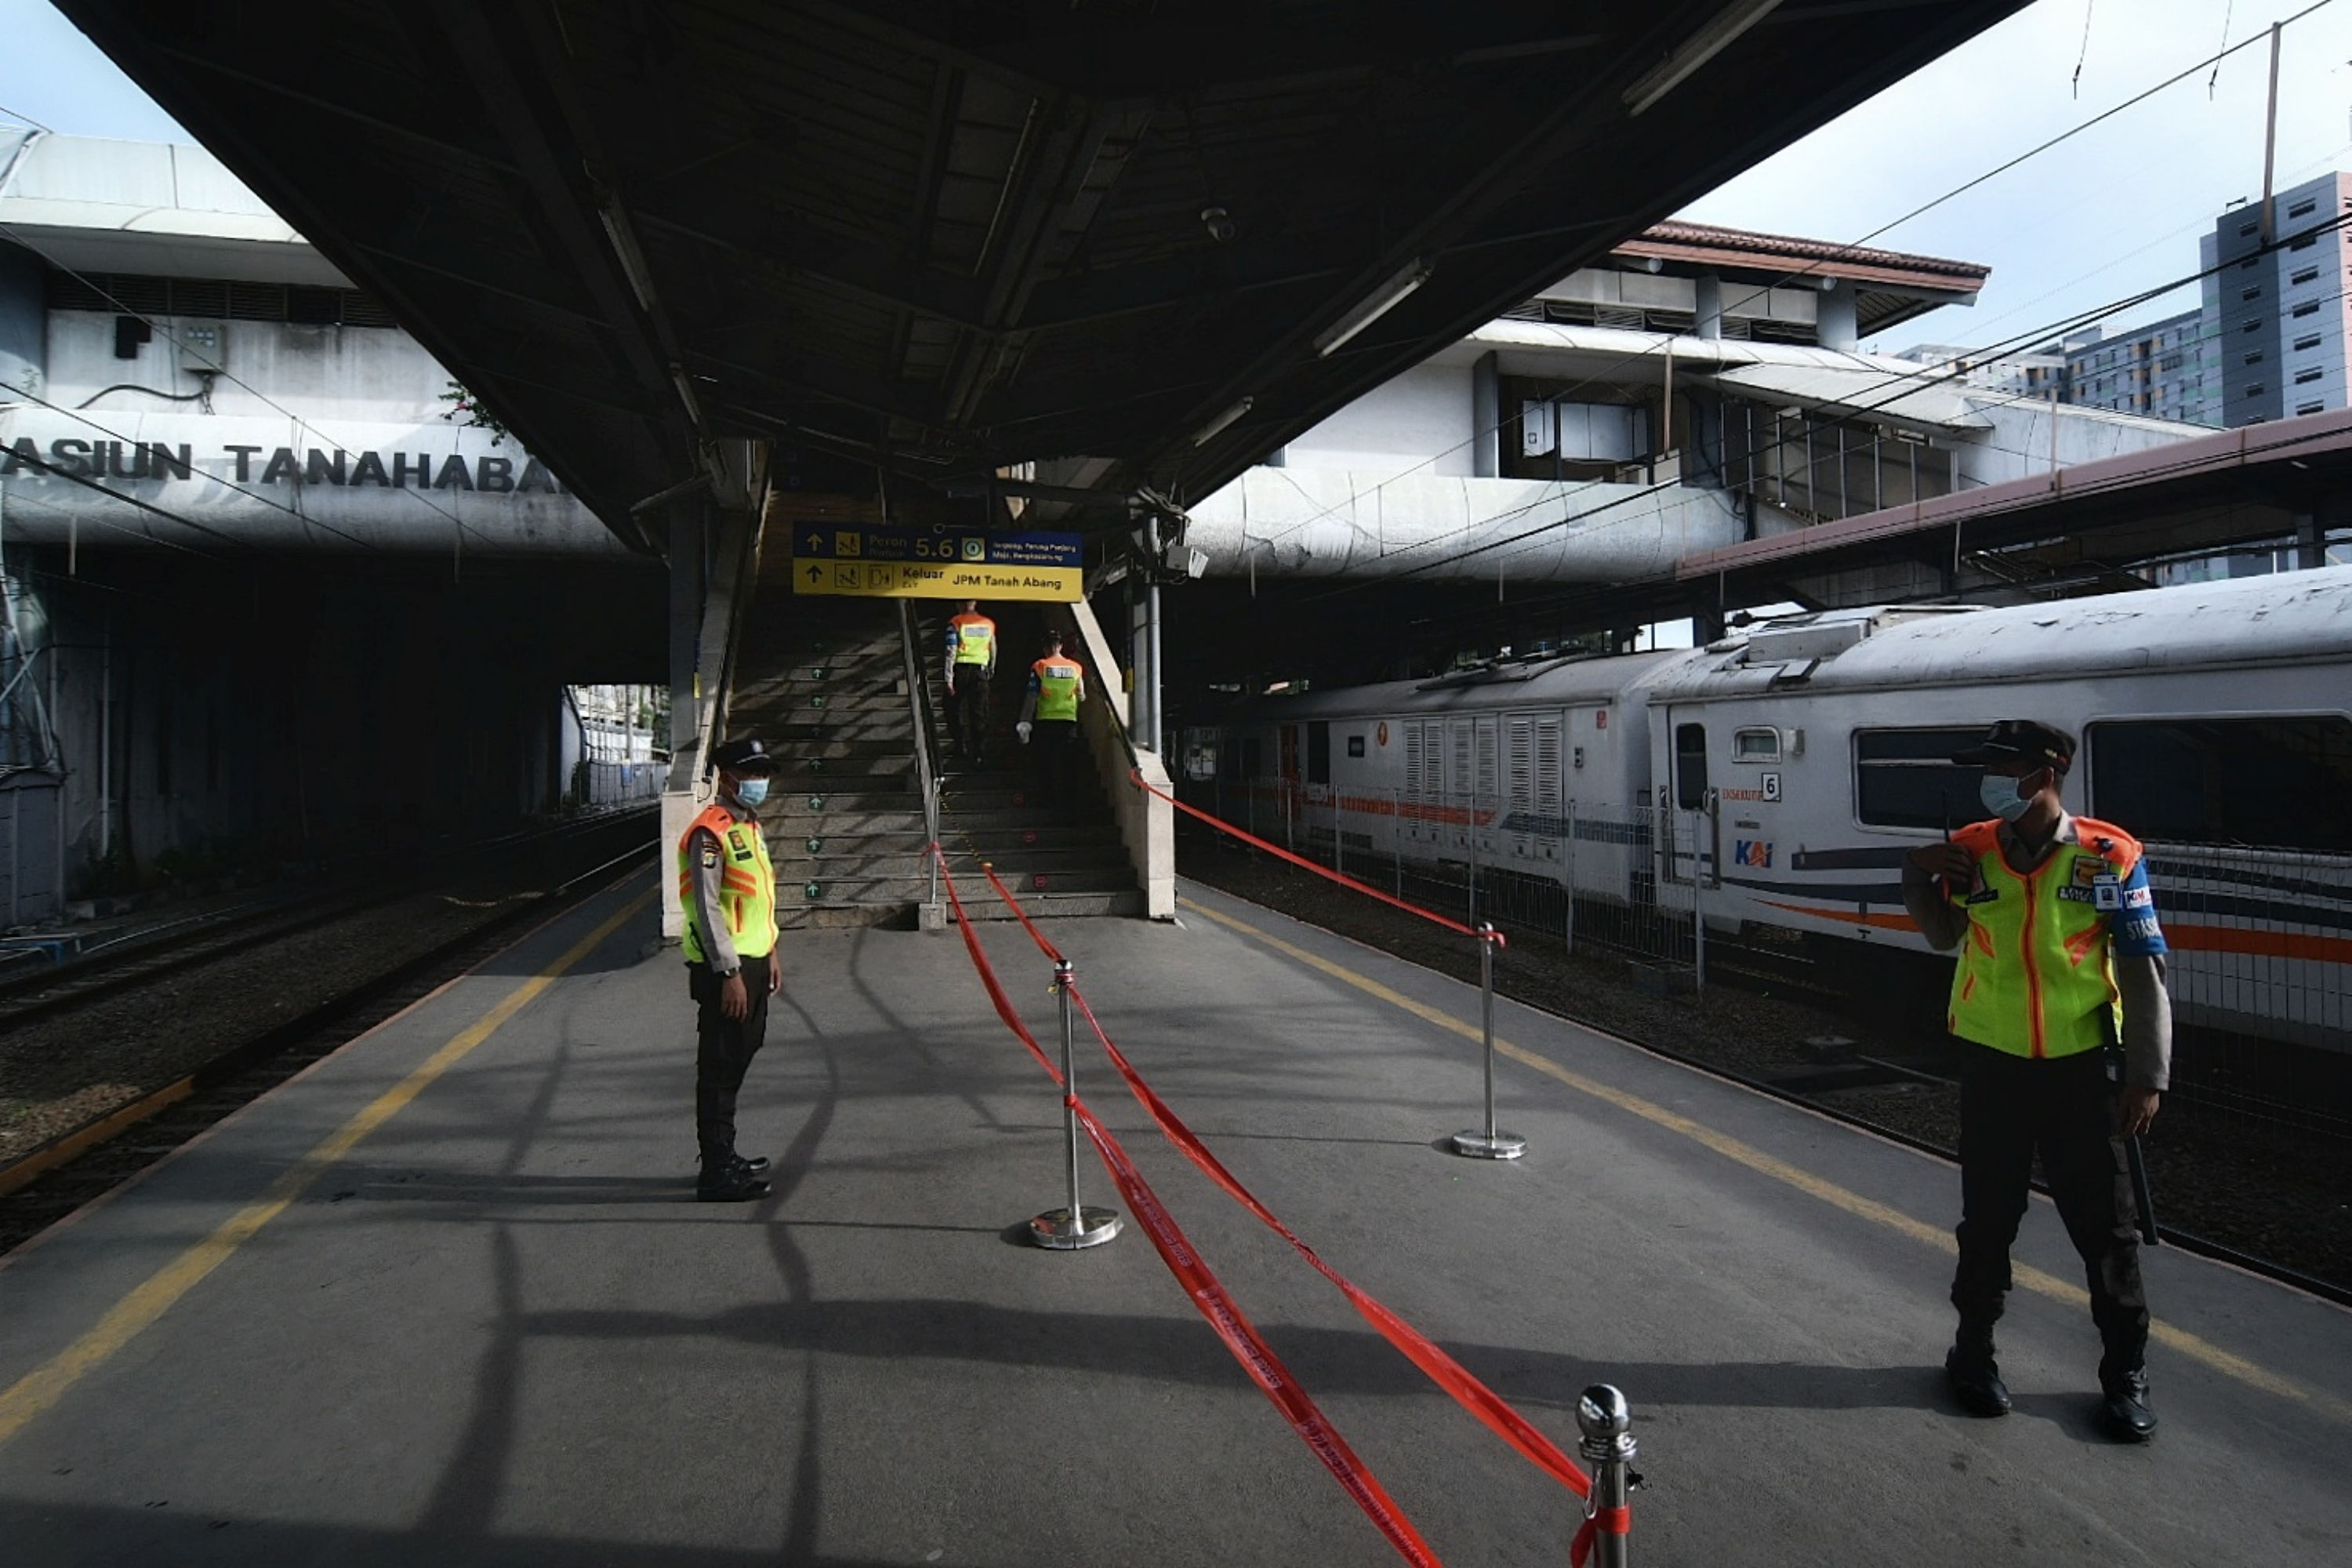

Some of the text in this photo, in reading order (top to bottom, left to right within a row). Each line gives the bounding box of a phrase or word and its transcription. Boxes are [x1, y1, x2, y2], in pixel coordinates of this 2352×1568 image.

[0, 437, 571, 494] ASIUN TANAHABA
[902, 567, 1062, 590] Keluar JPM Tanah Abang
[1766, 778, 1775, 794] 6
